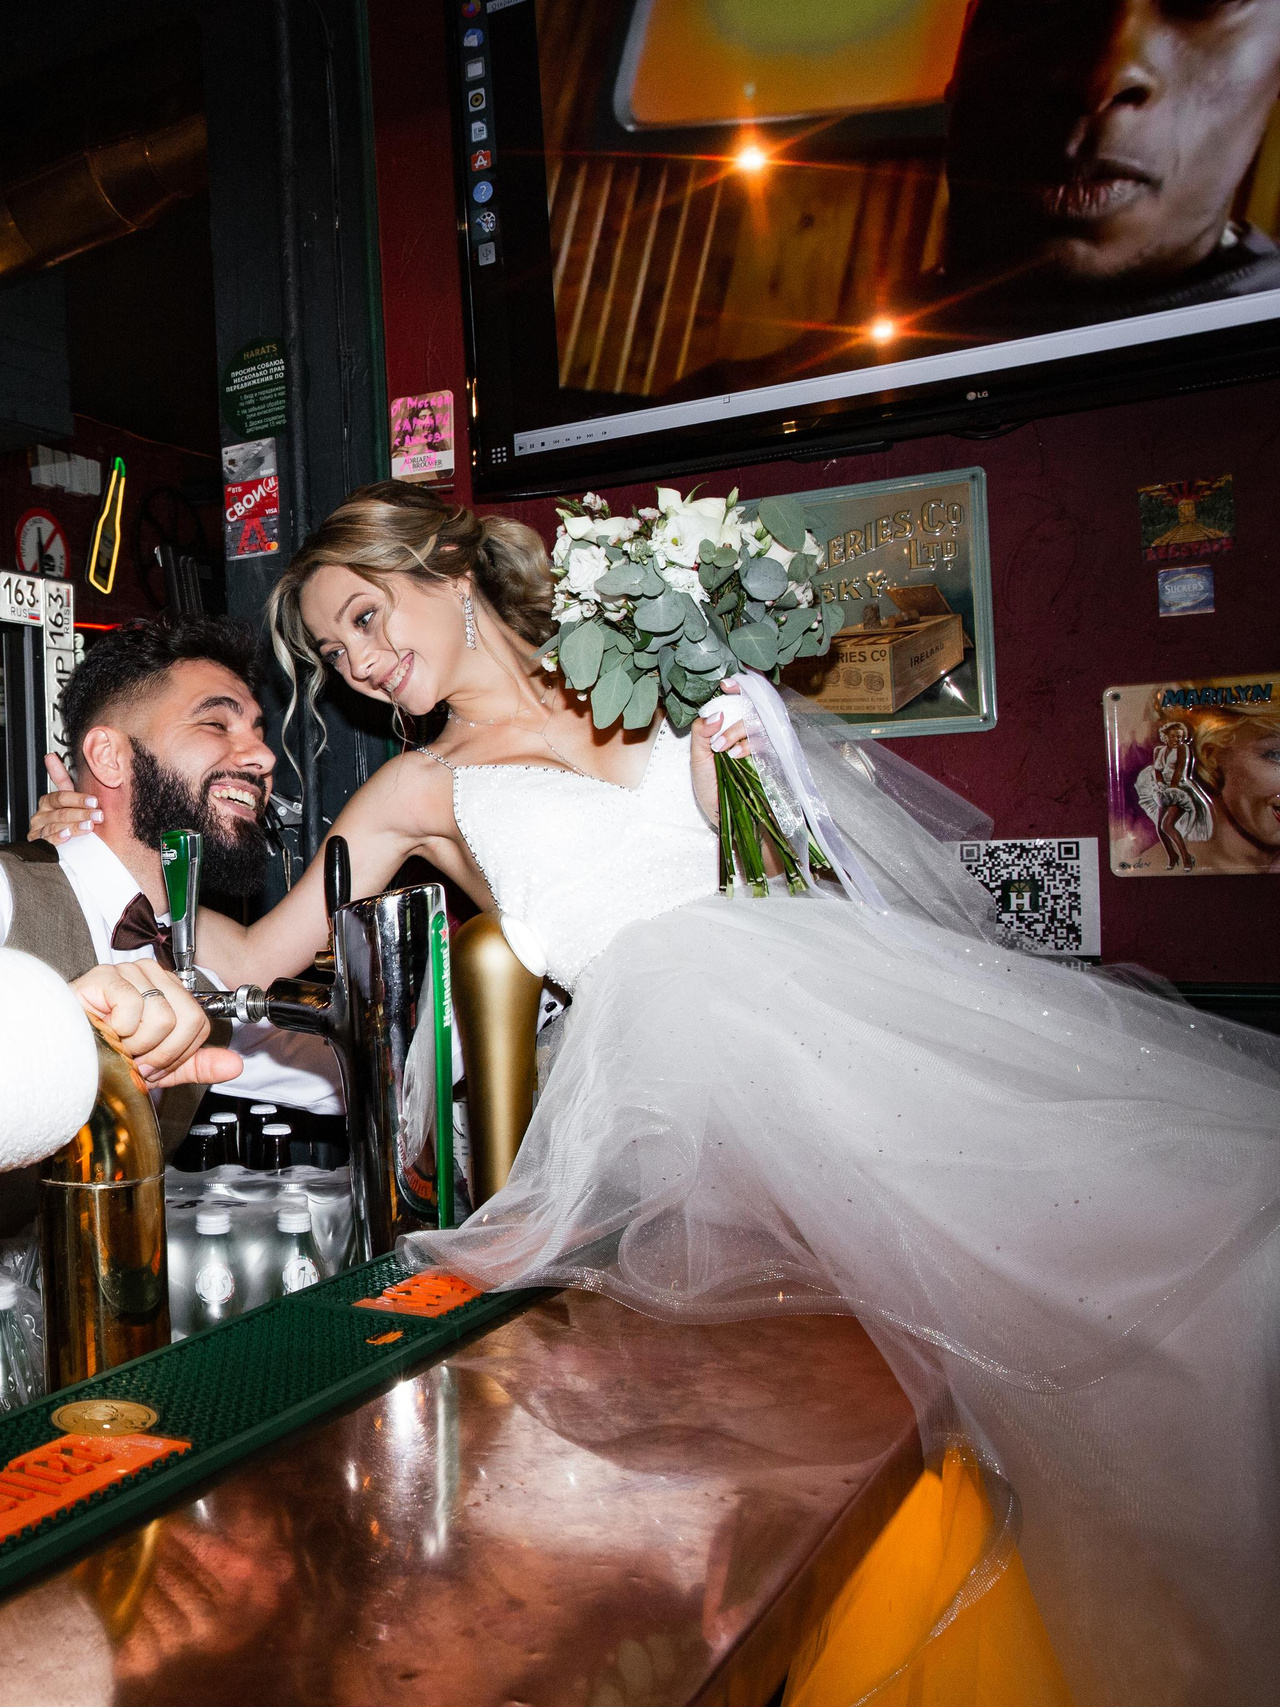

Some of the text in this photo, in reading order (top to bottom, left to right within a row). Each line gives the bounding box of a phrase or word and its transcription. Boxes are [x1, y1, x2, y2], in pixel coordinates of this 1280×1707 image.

[231, 365, 256, 378] ПРОСИМ
[233, 369, 268, 384] НЕСКОЛЬКО
[225, 375, 273, 393] ПЕРЕДВИЖЕНИЯ
[3, 579, 36, 608] 163
[1164, 581, 1204, 595] SUCKERS
[11, 606, 28, 619] RUS
[49, 592, 64, 645] 163
[910, 642, 945, 667] IRELAND
[1162, 684, 1273, 708] MARILYN
[442, 947, 452, 1028] Heineken
